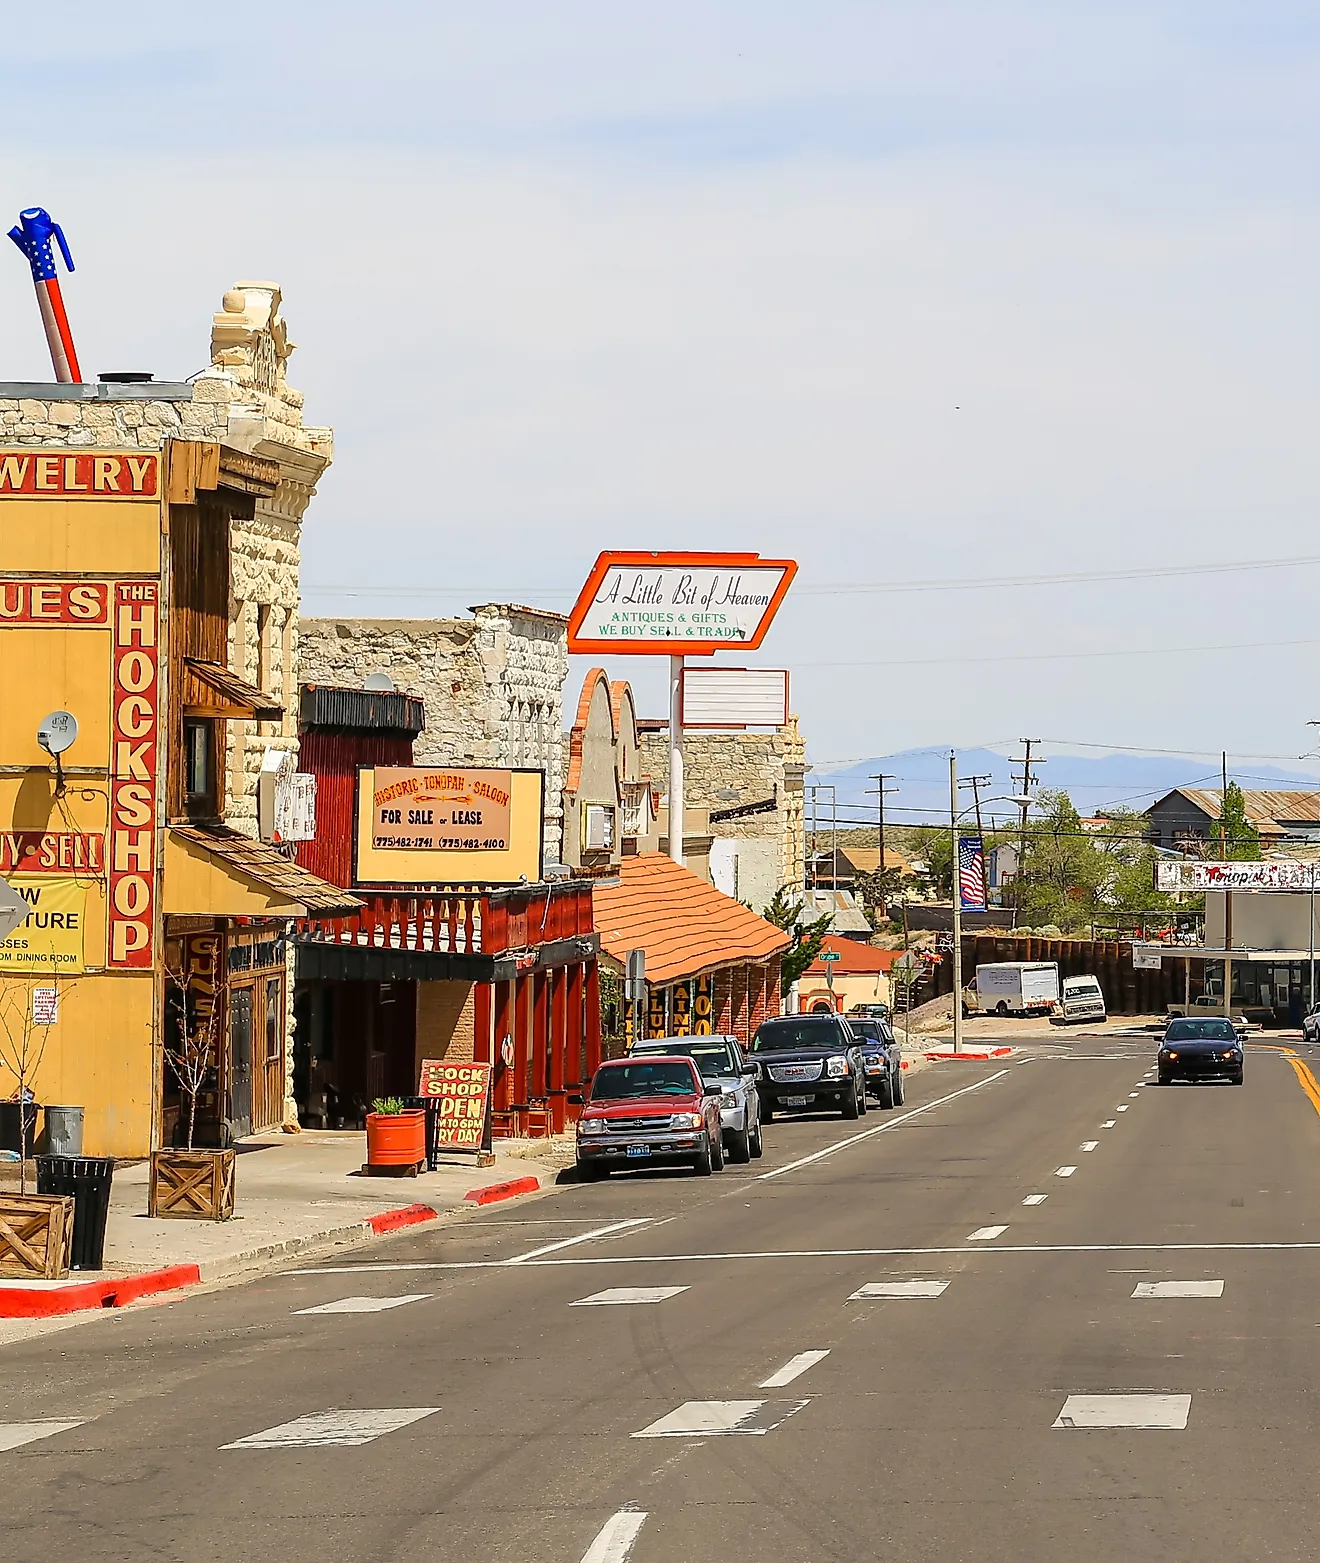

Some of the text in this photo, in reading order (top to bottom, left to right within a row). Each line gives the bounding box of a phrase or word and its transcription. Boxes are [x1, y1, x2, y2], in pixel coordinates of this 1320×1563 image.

[119, 585, 156, 601] THE
[595, 573, 770, 611] A Little Bit of Heaven
[611, 612, 727, 624] ANTIQUES & GIFTS
[599, 625, 618, 635] WE
[621, 625, 646, 635] BUY
[685, 627, 695, 636] &
[373, 775, 509, 807] HISTORIC TONOPAH SALOON
[381, 810, 402, 825] FOR
[407, 810, 433, 825] SALE
[452, 810, 482, 825] LEASE
[373, 837, 505, 849] (775)482-1741 (775)482-4100
[40, 835, 100, 868] SELL
[17, 953, 48, 962] DINING
[50, 954, 77, 963] ROOM
[427, 1082, 483, 1096] SHOP
[440, 1097, 482, 1118] PEN
[457, 1129, 481, 1143] DAY
